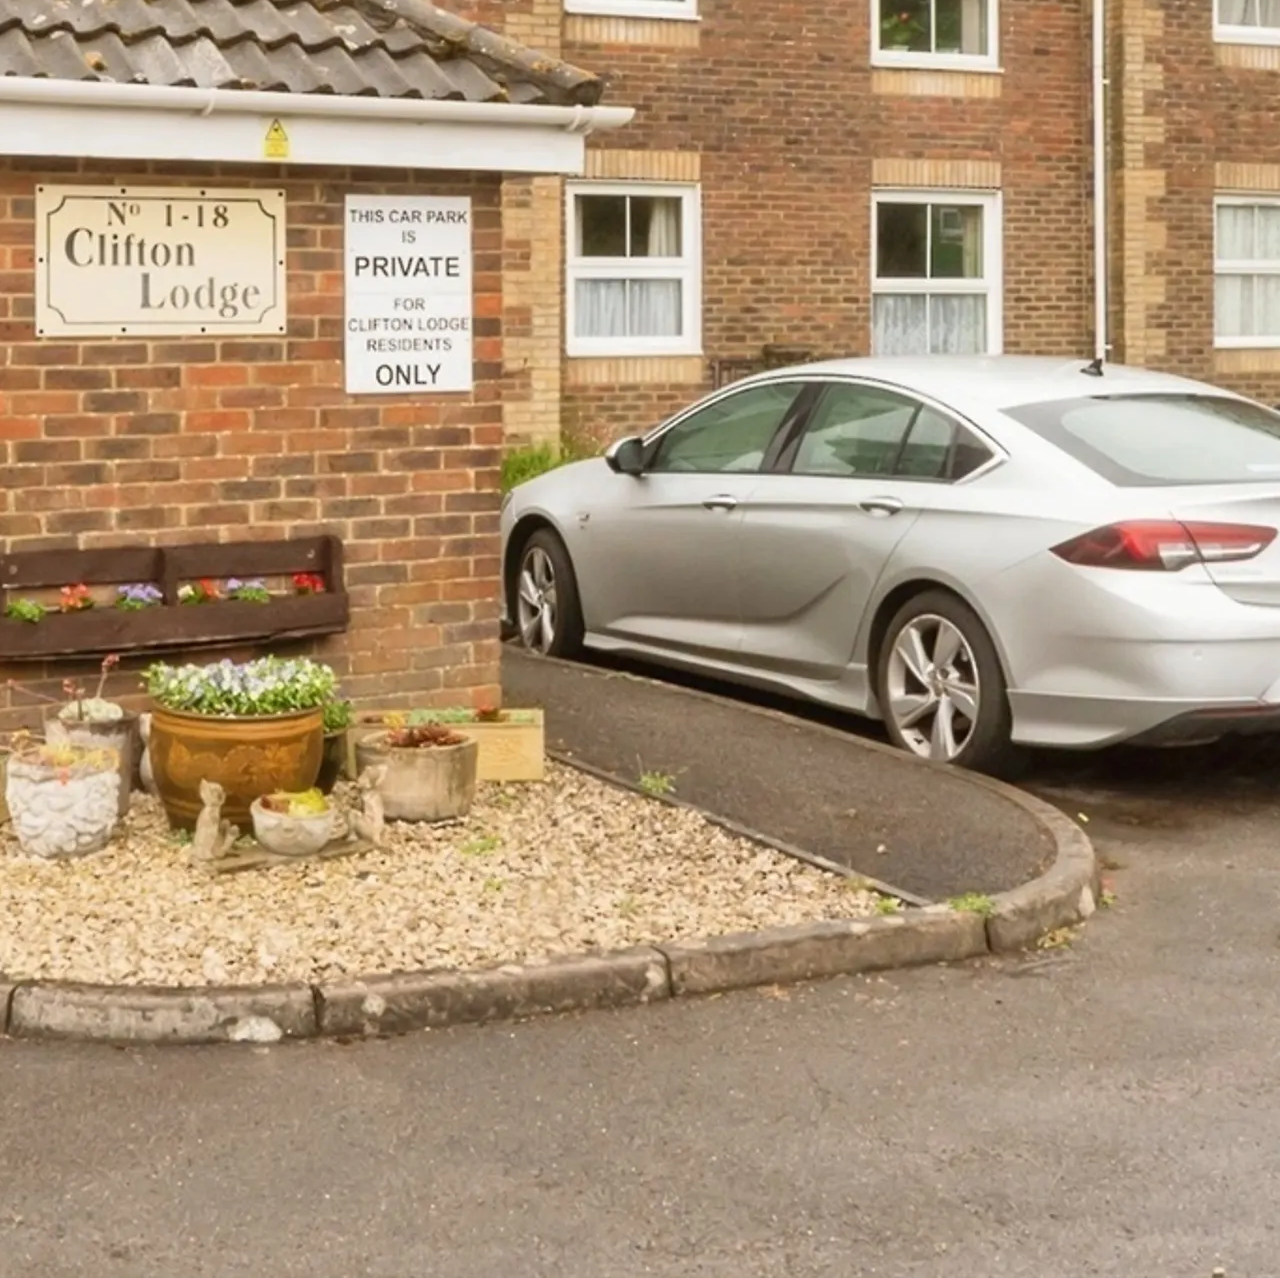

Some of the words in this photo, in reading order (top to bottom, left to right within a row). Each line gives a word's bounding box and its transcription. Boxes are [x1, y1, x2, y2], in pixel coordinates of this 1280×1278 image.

[165, 204, 229, 228] 1-18
[350, 208, 385, 223] THIS
[388, 208, 422, 223] CAR
[426, 209, 468, 224] PARK
[401, 229, 417, 244] IS
[64, 227, 196, 268] Clifton
[354, 255, 461, 278] PRIVATE
[140, 272, 261, 319] Lodge
[393, 297, 426, 312] FOR
[347, 317, 413, 332] CLIFTON
[417, 317, 470, 332] LODGE
[366, 337, 453, 352] RESIDENTS
[375, 363, 442, 386] ONLY
